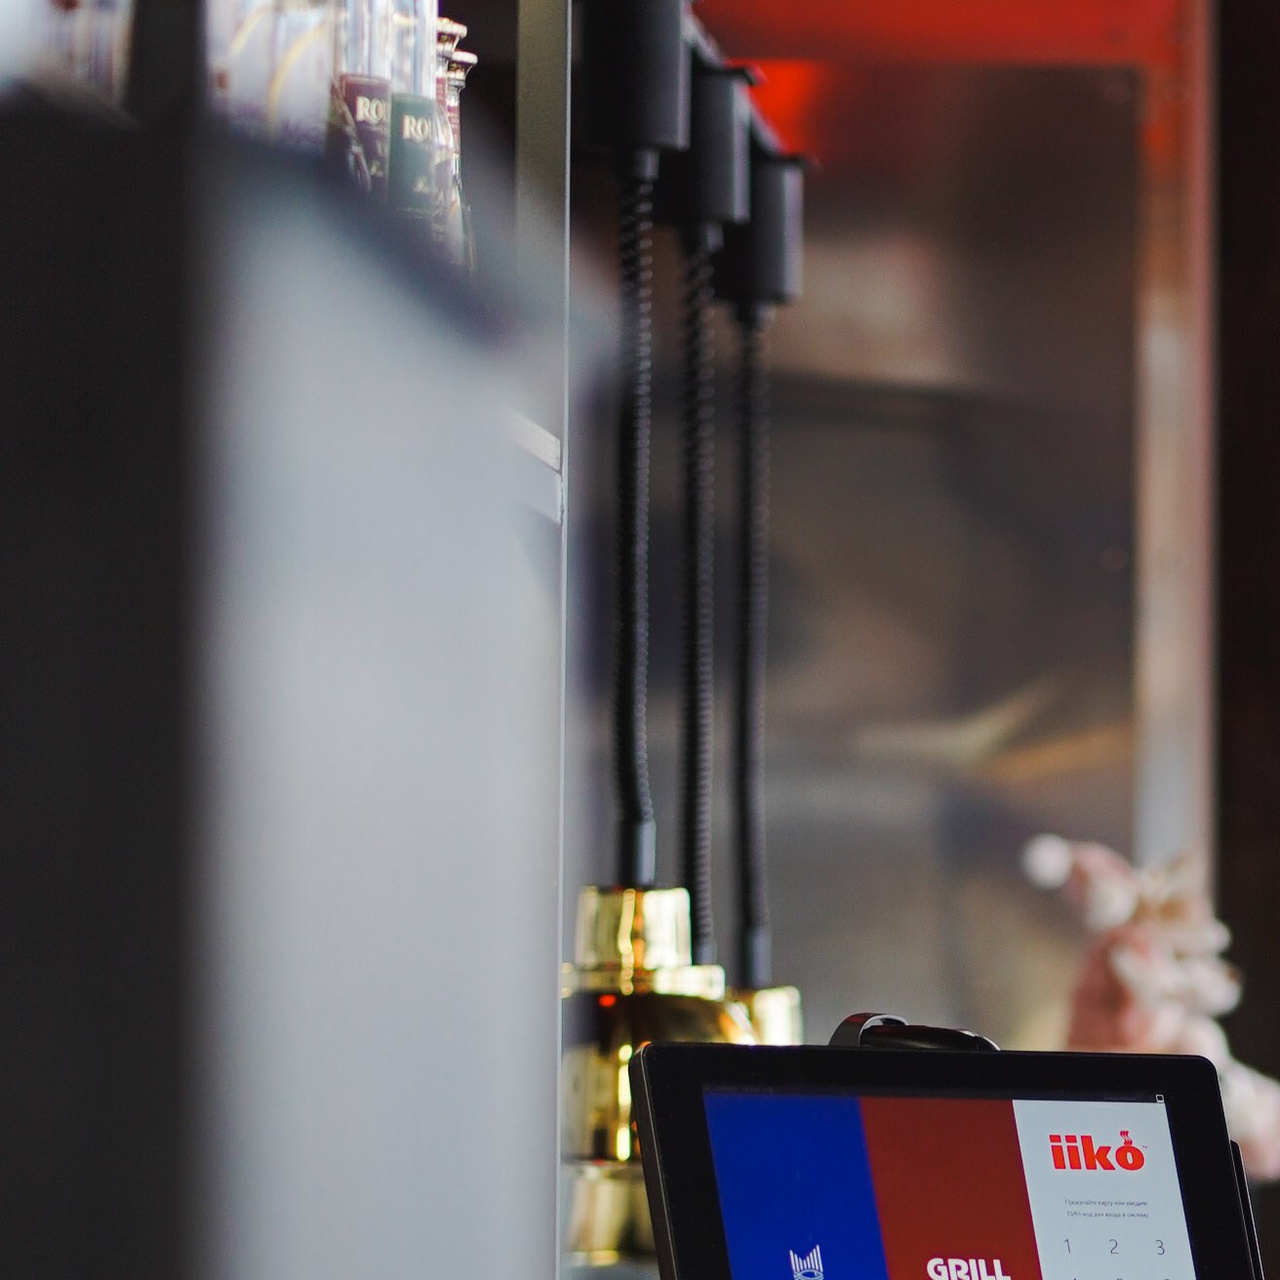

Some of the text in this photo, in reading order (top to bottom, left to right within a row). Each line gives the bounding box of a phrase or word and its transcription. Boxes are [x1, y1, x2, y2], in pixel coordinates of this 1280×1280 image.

[1049, 1131, 1145, 1171] iiko
[1064, 1238, 1166, 1256] 1 2 3
